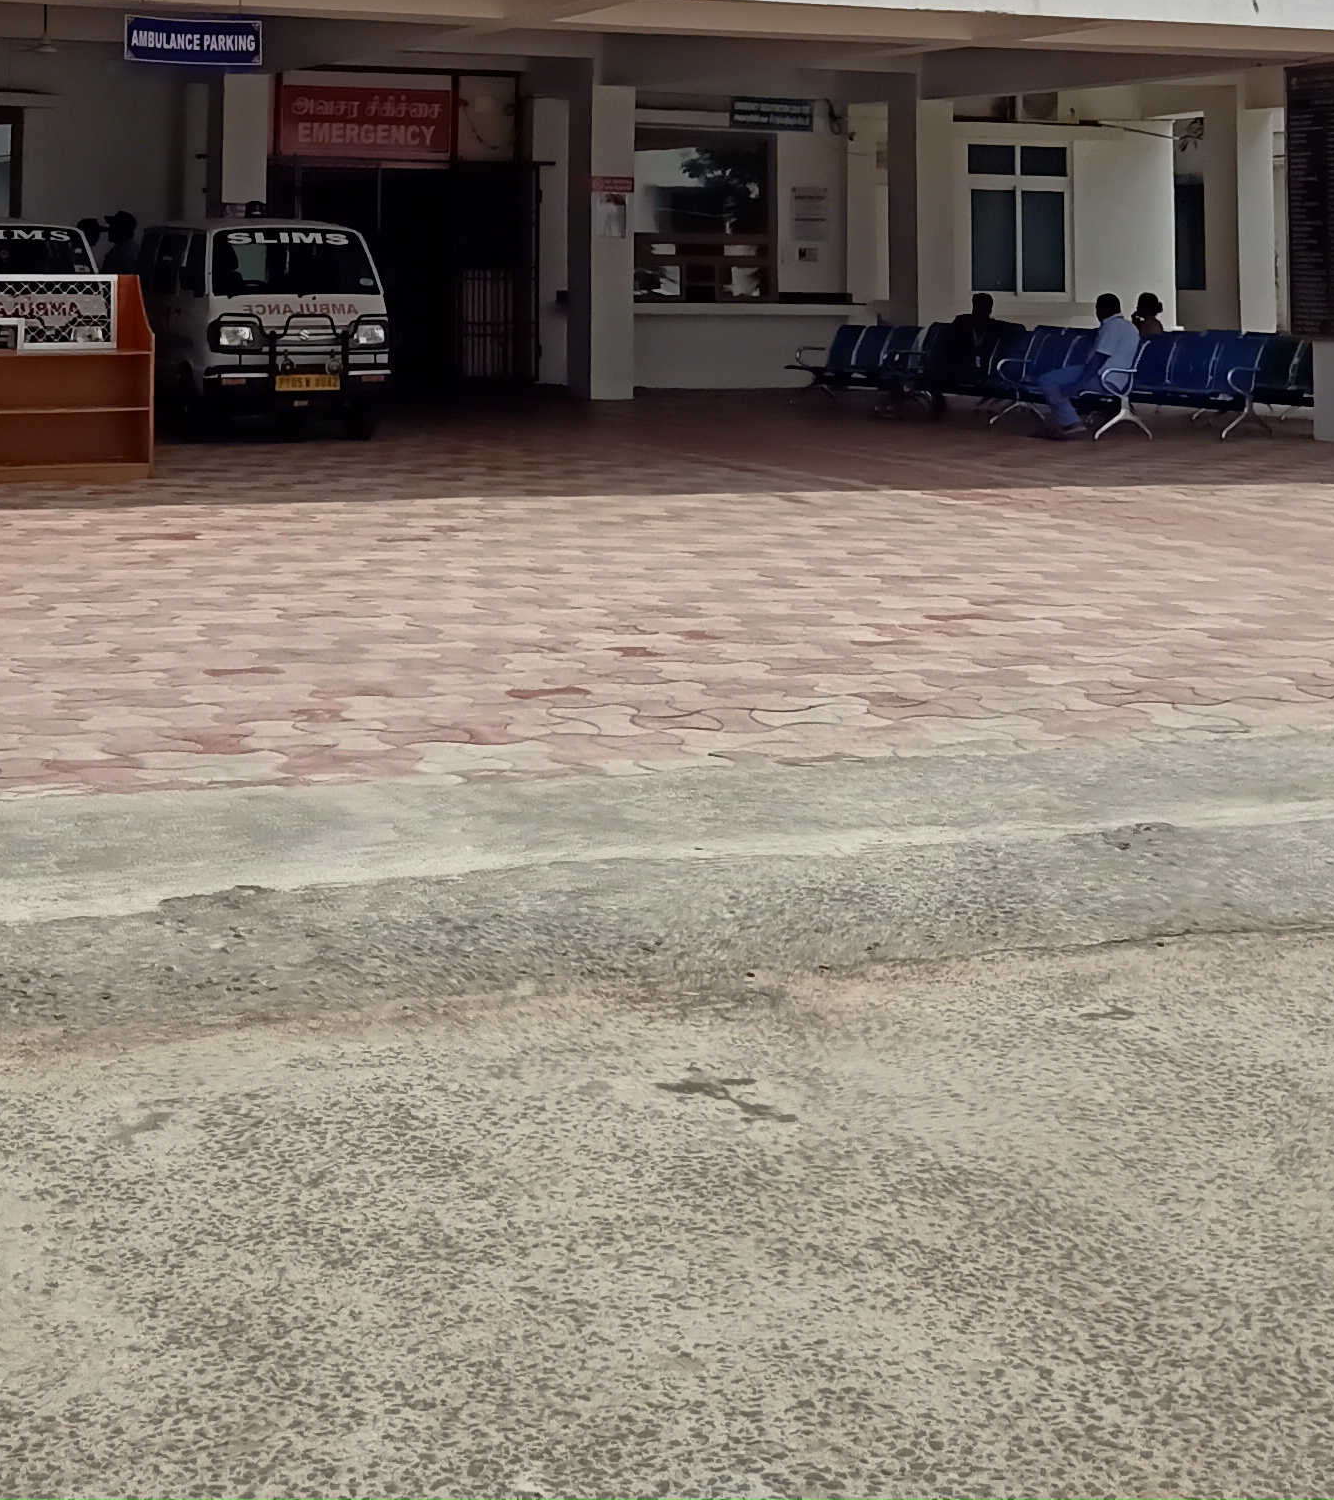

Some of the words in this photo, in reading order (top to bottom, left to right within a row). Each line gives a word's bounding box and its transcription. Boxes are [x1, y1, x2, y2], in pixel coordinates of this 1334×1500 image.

[131, 29, 201, 51] AMBULANCE
[203, 34, 256, 52] PARKING
[291, 96, 361, 119] அவசர
[364, 95, 443, 119] சிகிச்சை
[297, 121, 436, 147] EMERGENCY
[226, 231, 349, 245] SLIMS
